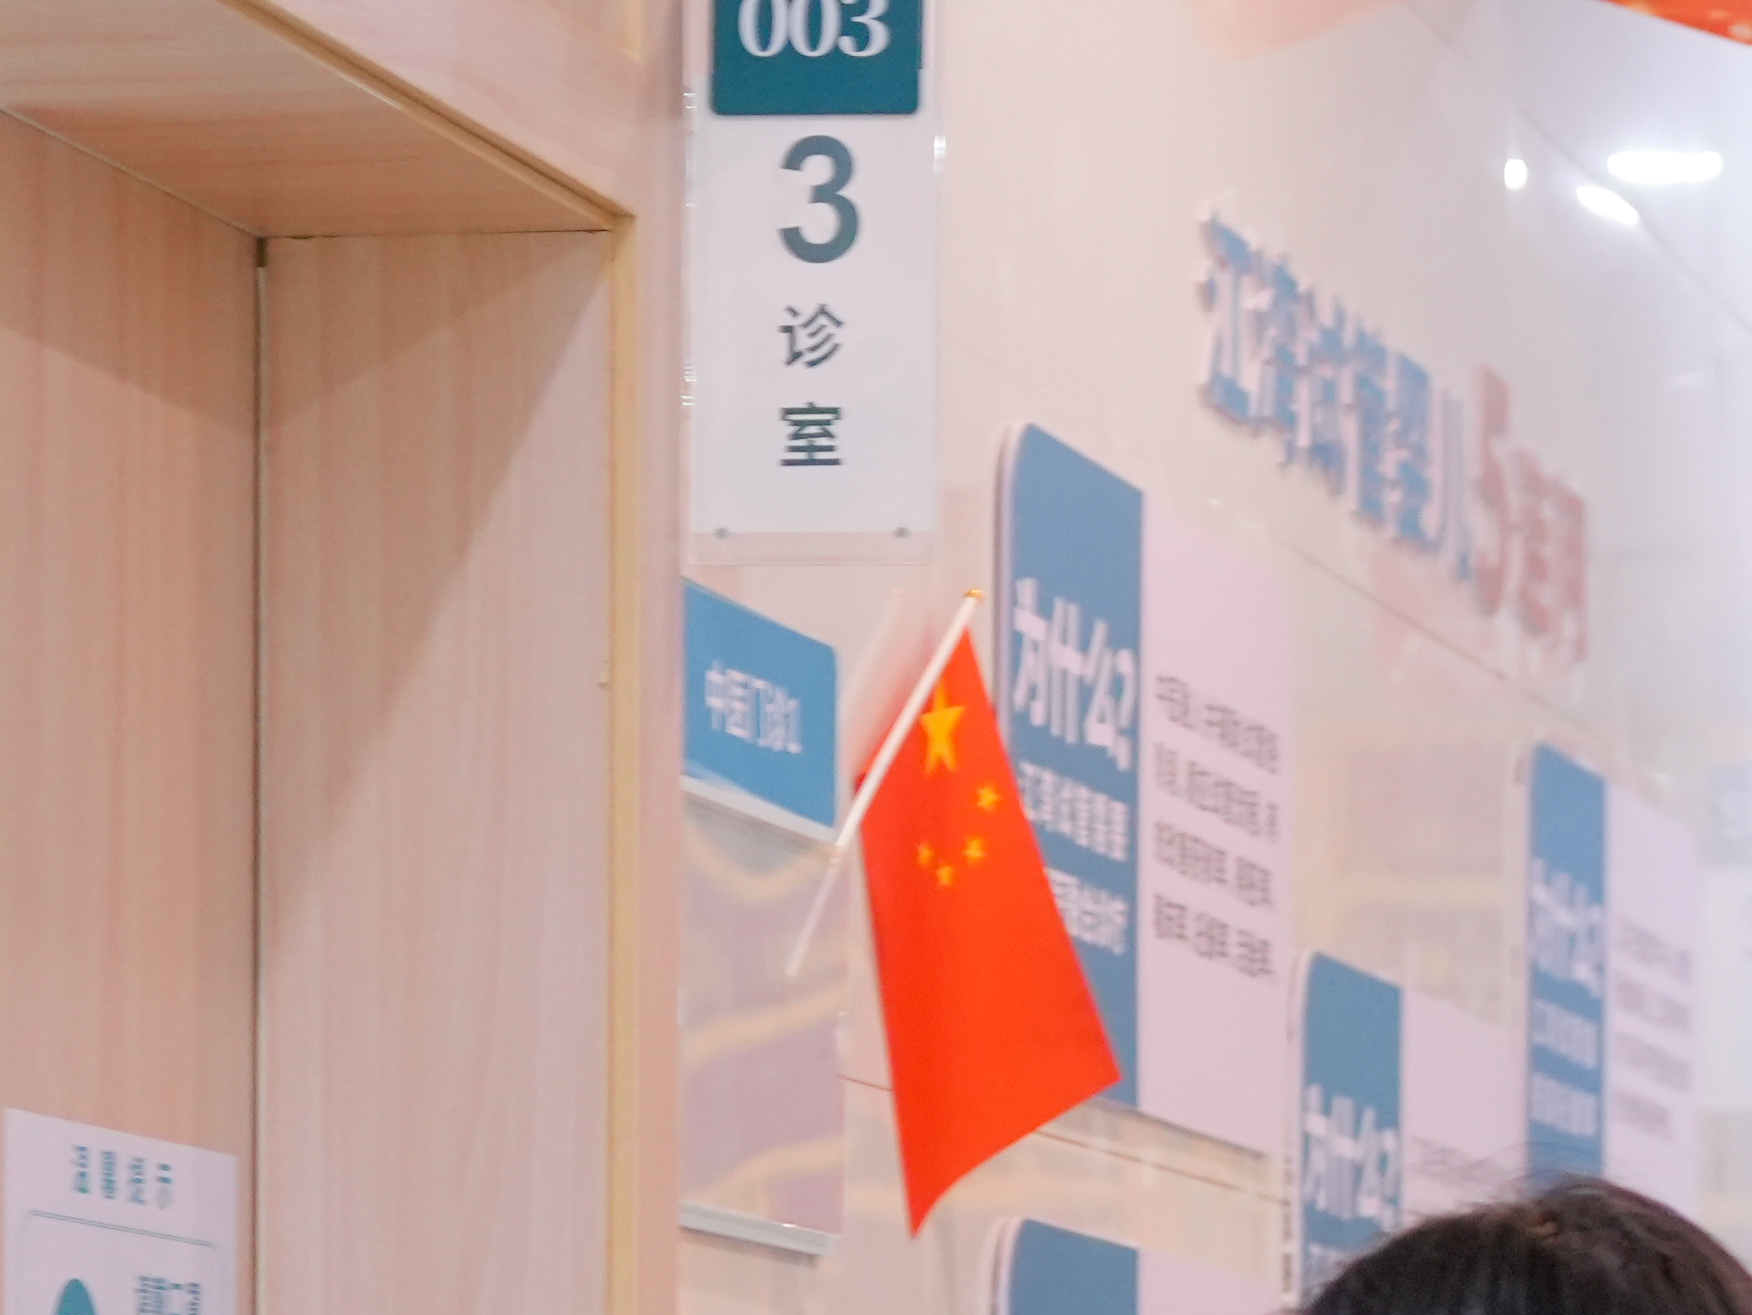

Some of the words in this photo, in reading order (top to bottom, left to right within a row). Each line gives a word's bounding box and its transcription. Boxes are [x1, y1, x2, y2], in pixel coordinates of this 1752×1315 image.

[738, 0, 890, 57] 003
[778, 135, 860, 264] 3
[778, 303, 845, 466] 诊室
[72, 1145, 174, 1210] 温馨提示
